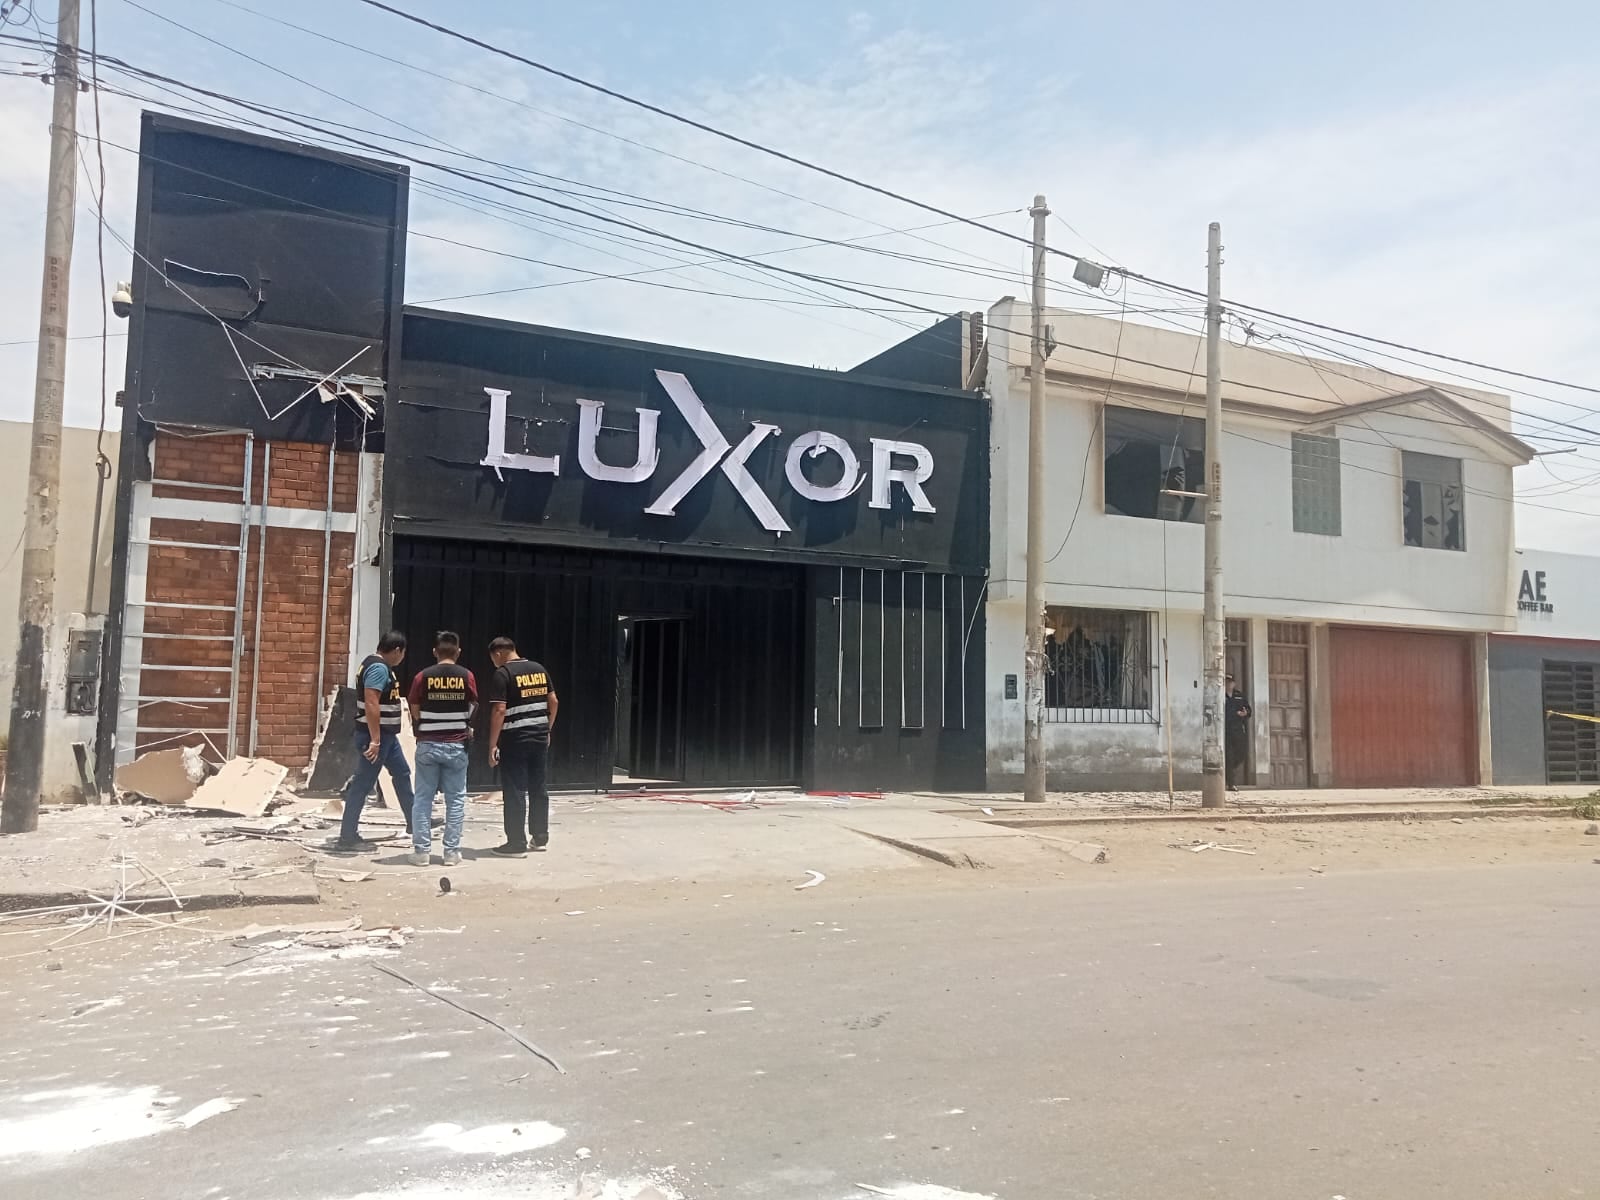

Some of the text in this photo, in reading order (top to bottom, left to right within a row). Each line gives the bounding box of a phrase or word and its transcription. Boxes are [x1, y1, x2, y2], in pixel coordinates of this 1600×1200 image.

[480, 369, 937, 535] LUXOR
[1516, 600, 1554, 614] OFFEE BAR
[427, 677, 465, 690] POLICIA
[516, 672, 547, 688] POLICIA
